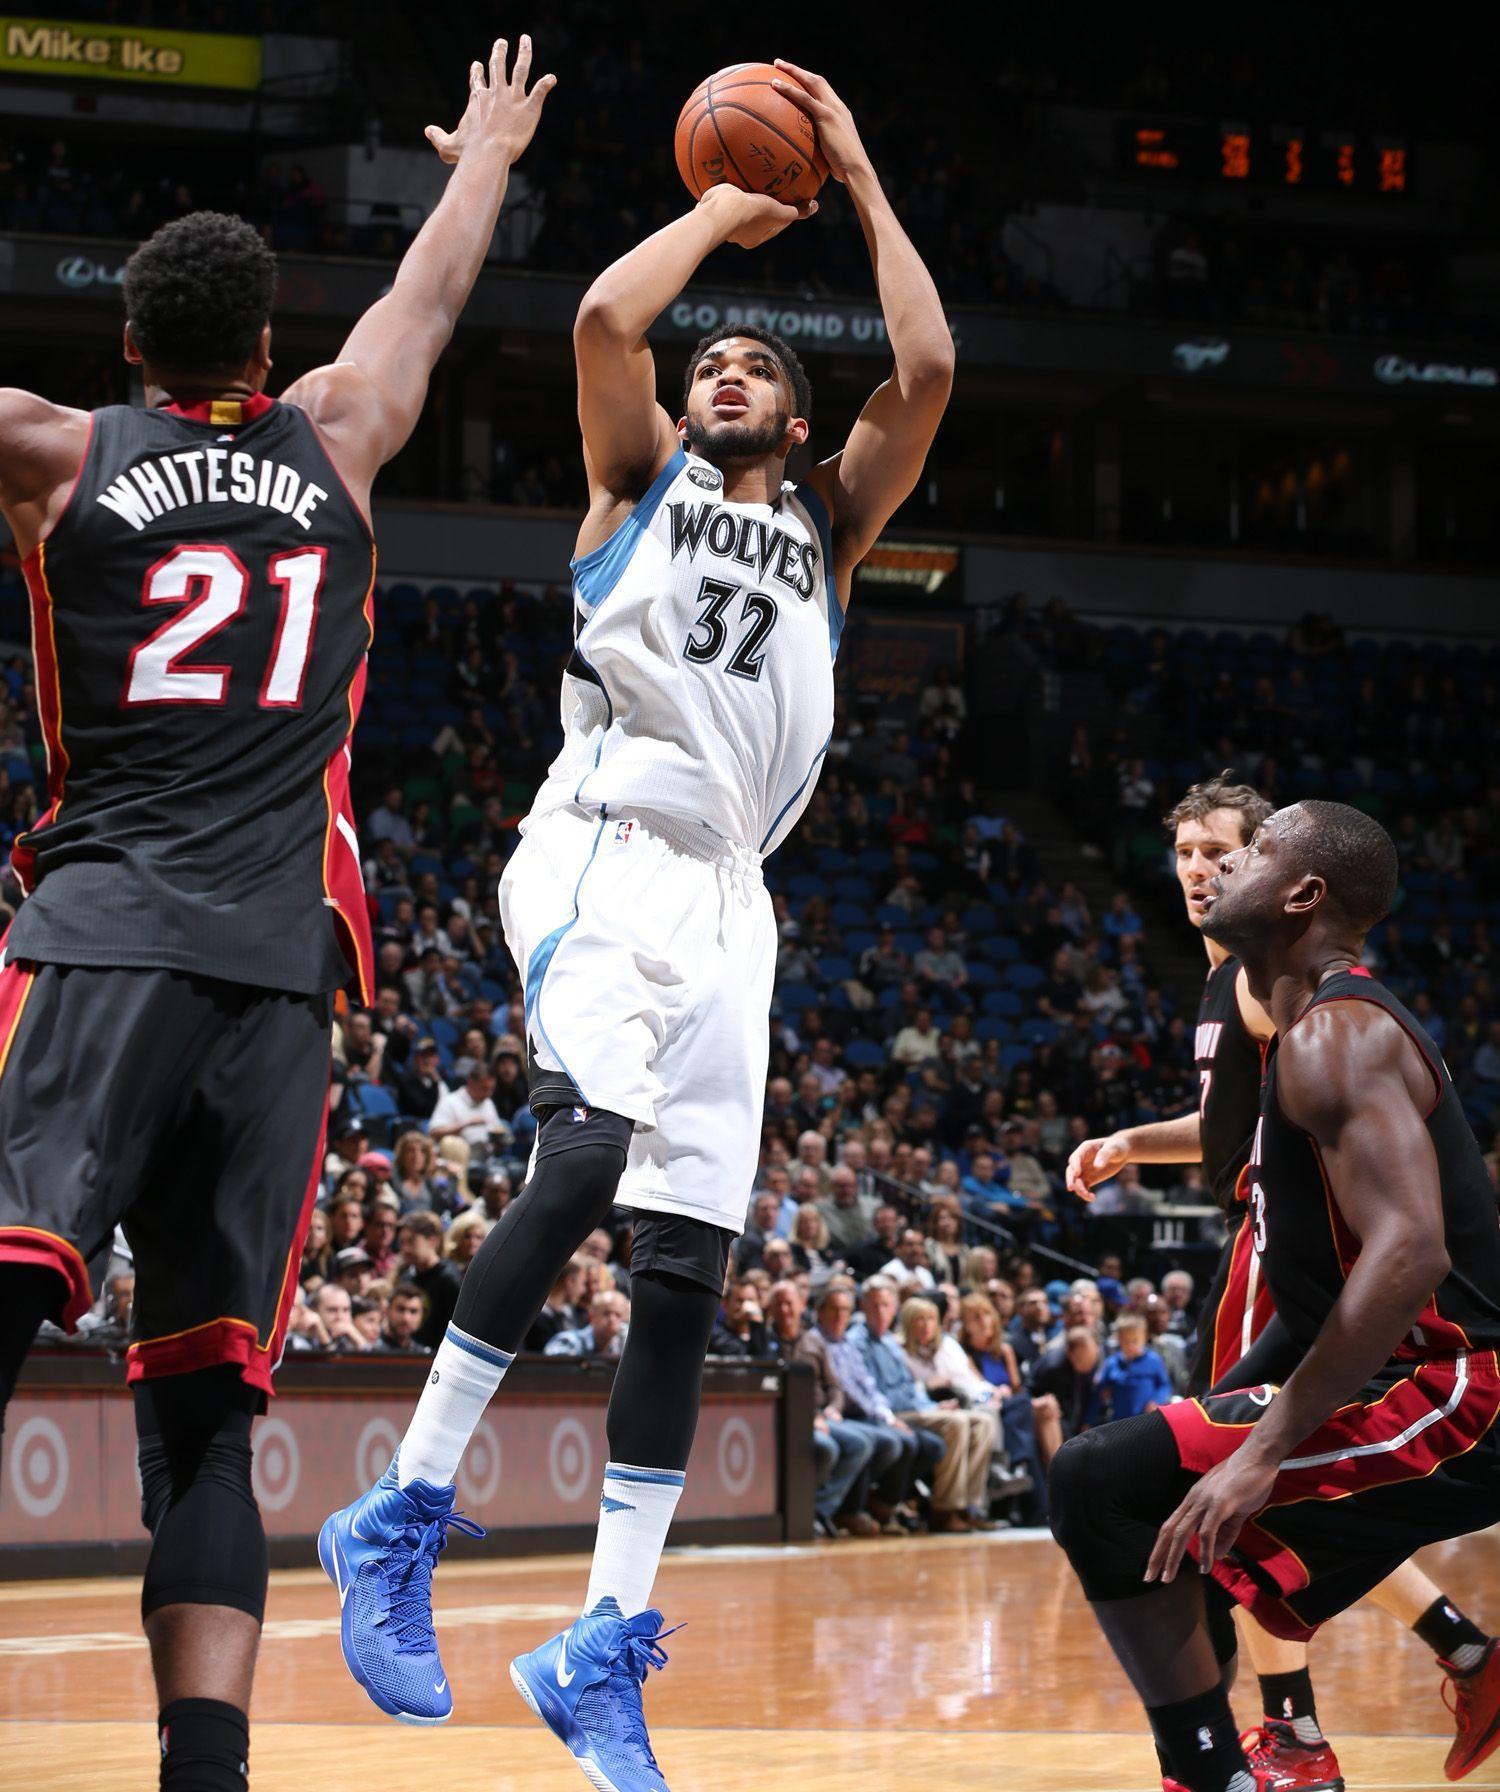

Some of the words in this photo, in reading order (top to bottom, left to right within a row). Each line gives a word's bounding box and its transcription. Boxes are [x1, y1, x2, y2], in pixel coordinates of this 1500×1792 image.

[7, 25, 111, 64] Mike
[121, 39, 183, 74] Ike
[672, 303, 719, 329] GO
[725, 307, 845, 338] BEYOND
[97, 448, 328, 531] WHITESIDE
[667, 500, 820, 602] WOLVES
[119, 543, 328, 709] 21
[683, 576, 778, 681] 32
